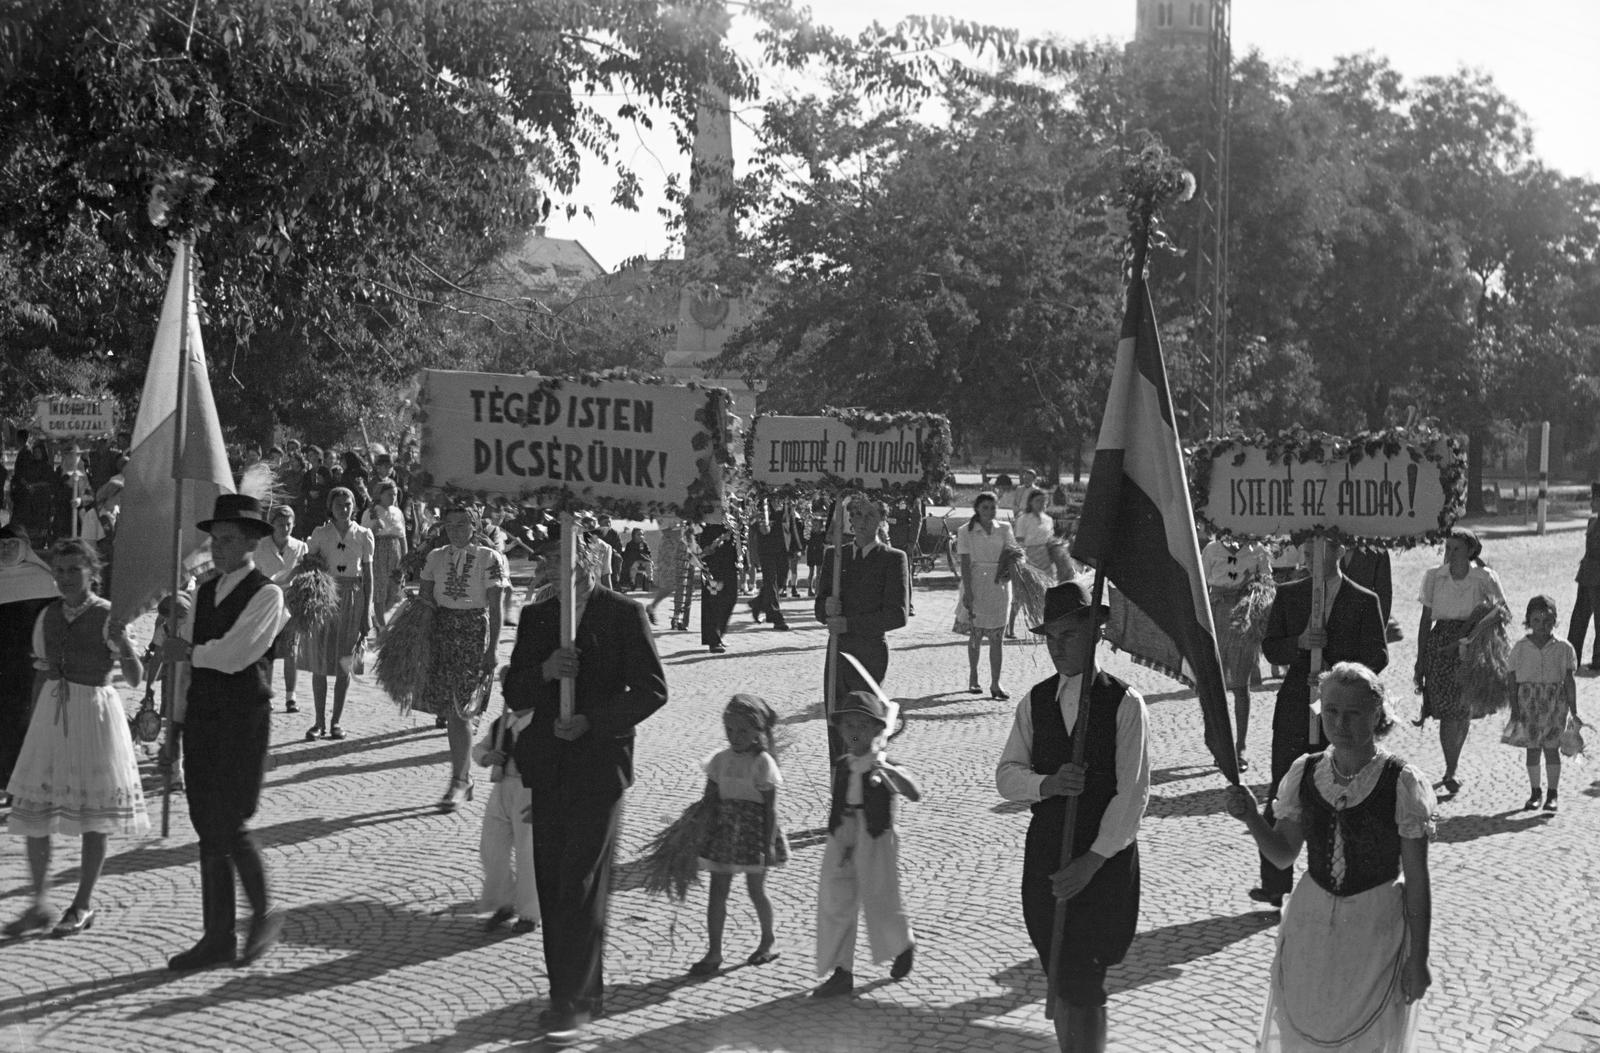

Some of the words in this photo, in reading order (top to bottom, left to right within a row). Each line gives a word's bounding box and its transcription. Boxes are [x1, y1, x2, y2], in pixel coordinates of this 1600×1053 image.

[470, 385, 561, 426] TÉGED
[567, 395, 654, 434] ISTEN
[474, 435, 668, 489] DICSÉRÜNK!
[833, 440, 846, 473] A
[1230, 462, 1295, 517] ISTENÉ
[1301, 478, 1328, 517] AZ
[1338, 462, 1418, 518] ÁLDÁS!
